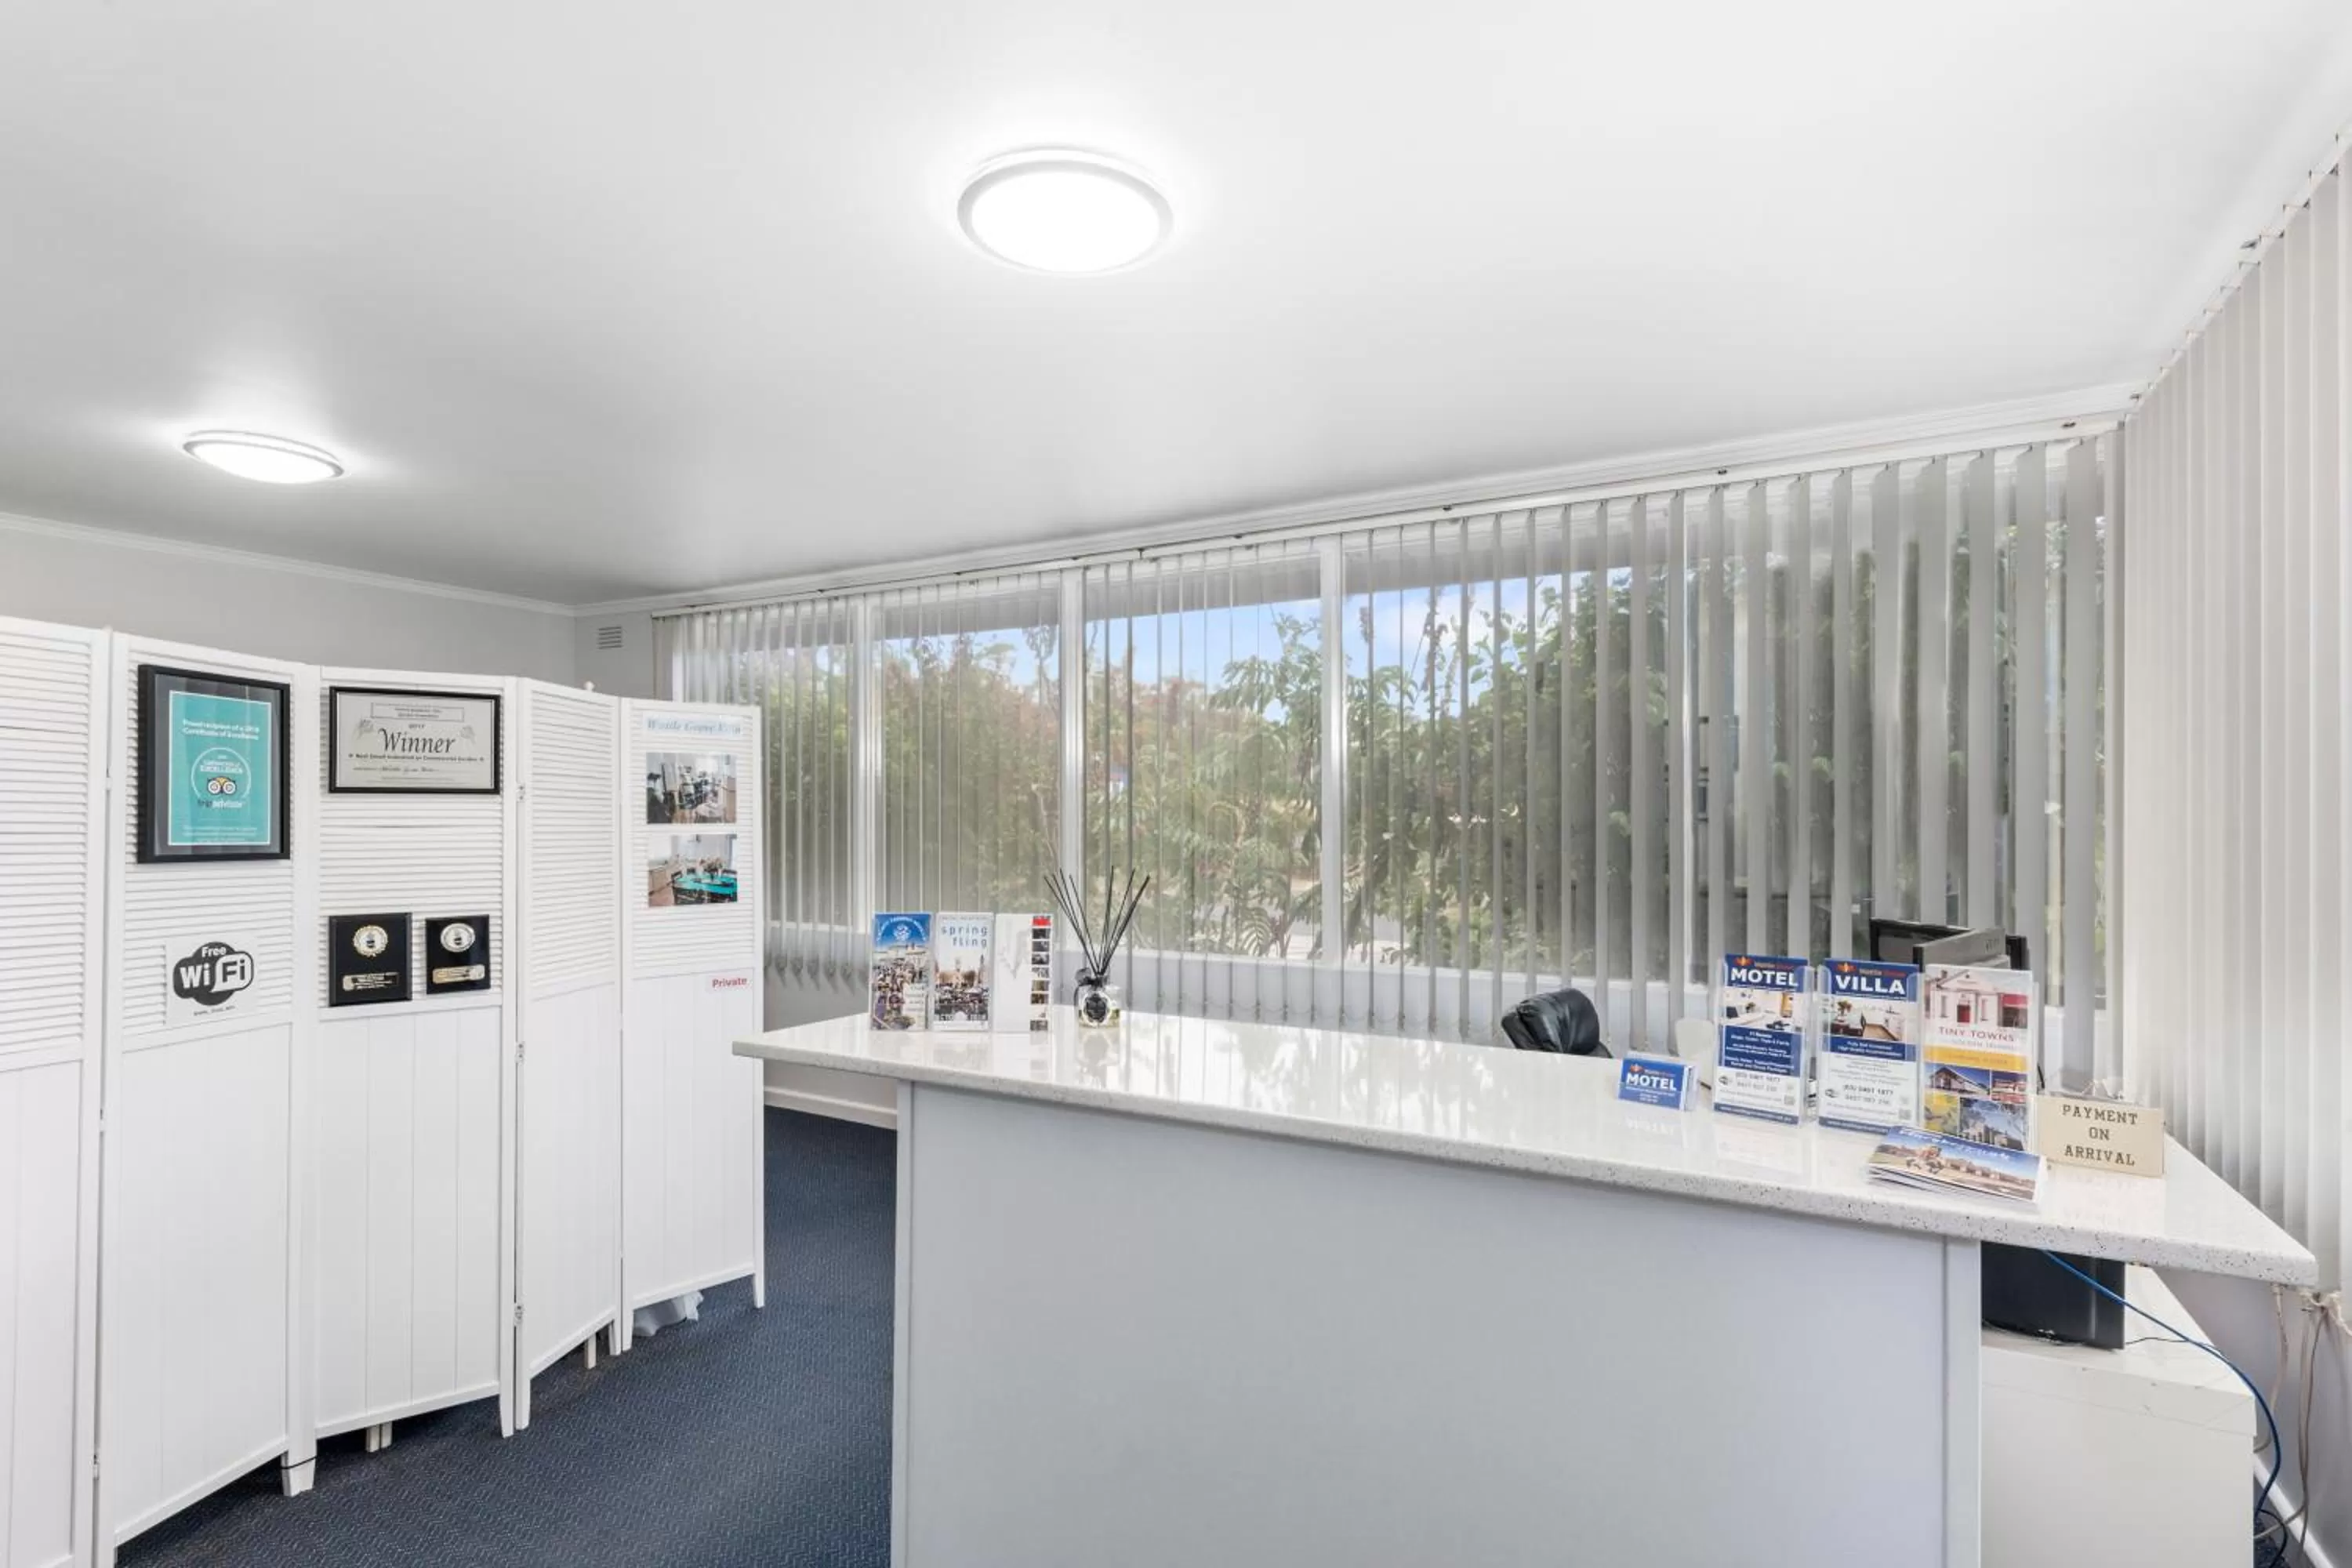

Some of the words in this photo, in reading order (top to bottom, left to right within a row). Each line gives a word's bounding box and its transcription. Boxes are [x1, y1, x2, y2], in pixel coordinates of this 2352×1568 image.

[378, 728, 456, 753] Winner
[941, 923, 988, 937] spring
[201, 946, 227, 957] Free
[953, 936, 987, 949] fling
[711, 977, 748, 989] Private
[1730, 967, 1798, 987] MOTEL
[1835, 975, 1905, 995] VILLA
[1939, 1026, 1965, 1036] TINY
[1970, 1030, 2014, 1042] TOWNS
[1626, 1072, 1677, 1092] MOTEL
[2062, 1104, 2138, 1125] PAYMENT
[2089, 1127, 2110, 1141] ON
[2064, 1144, 2135, 1167] ARRIVAL
